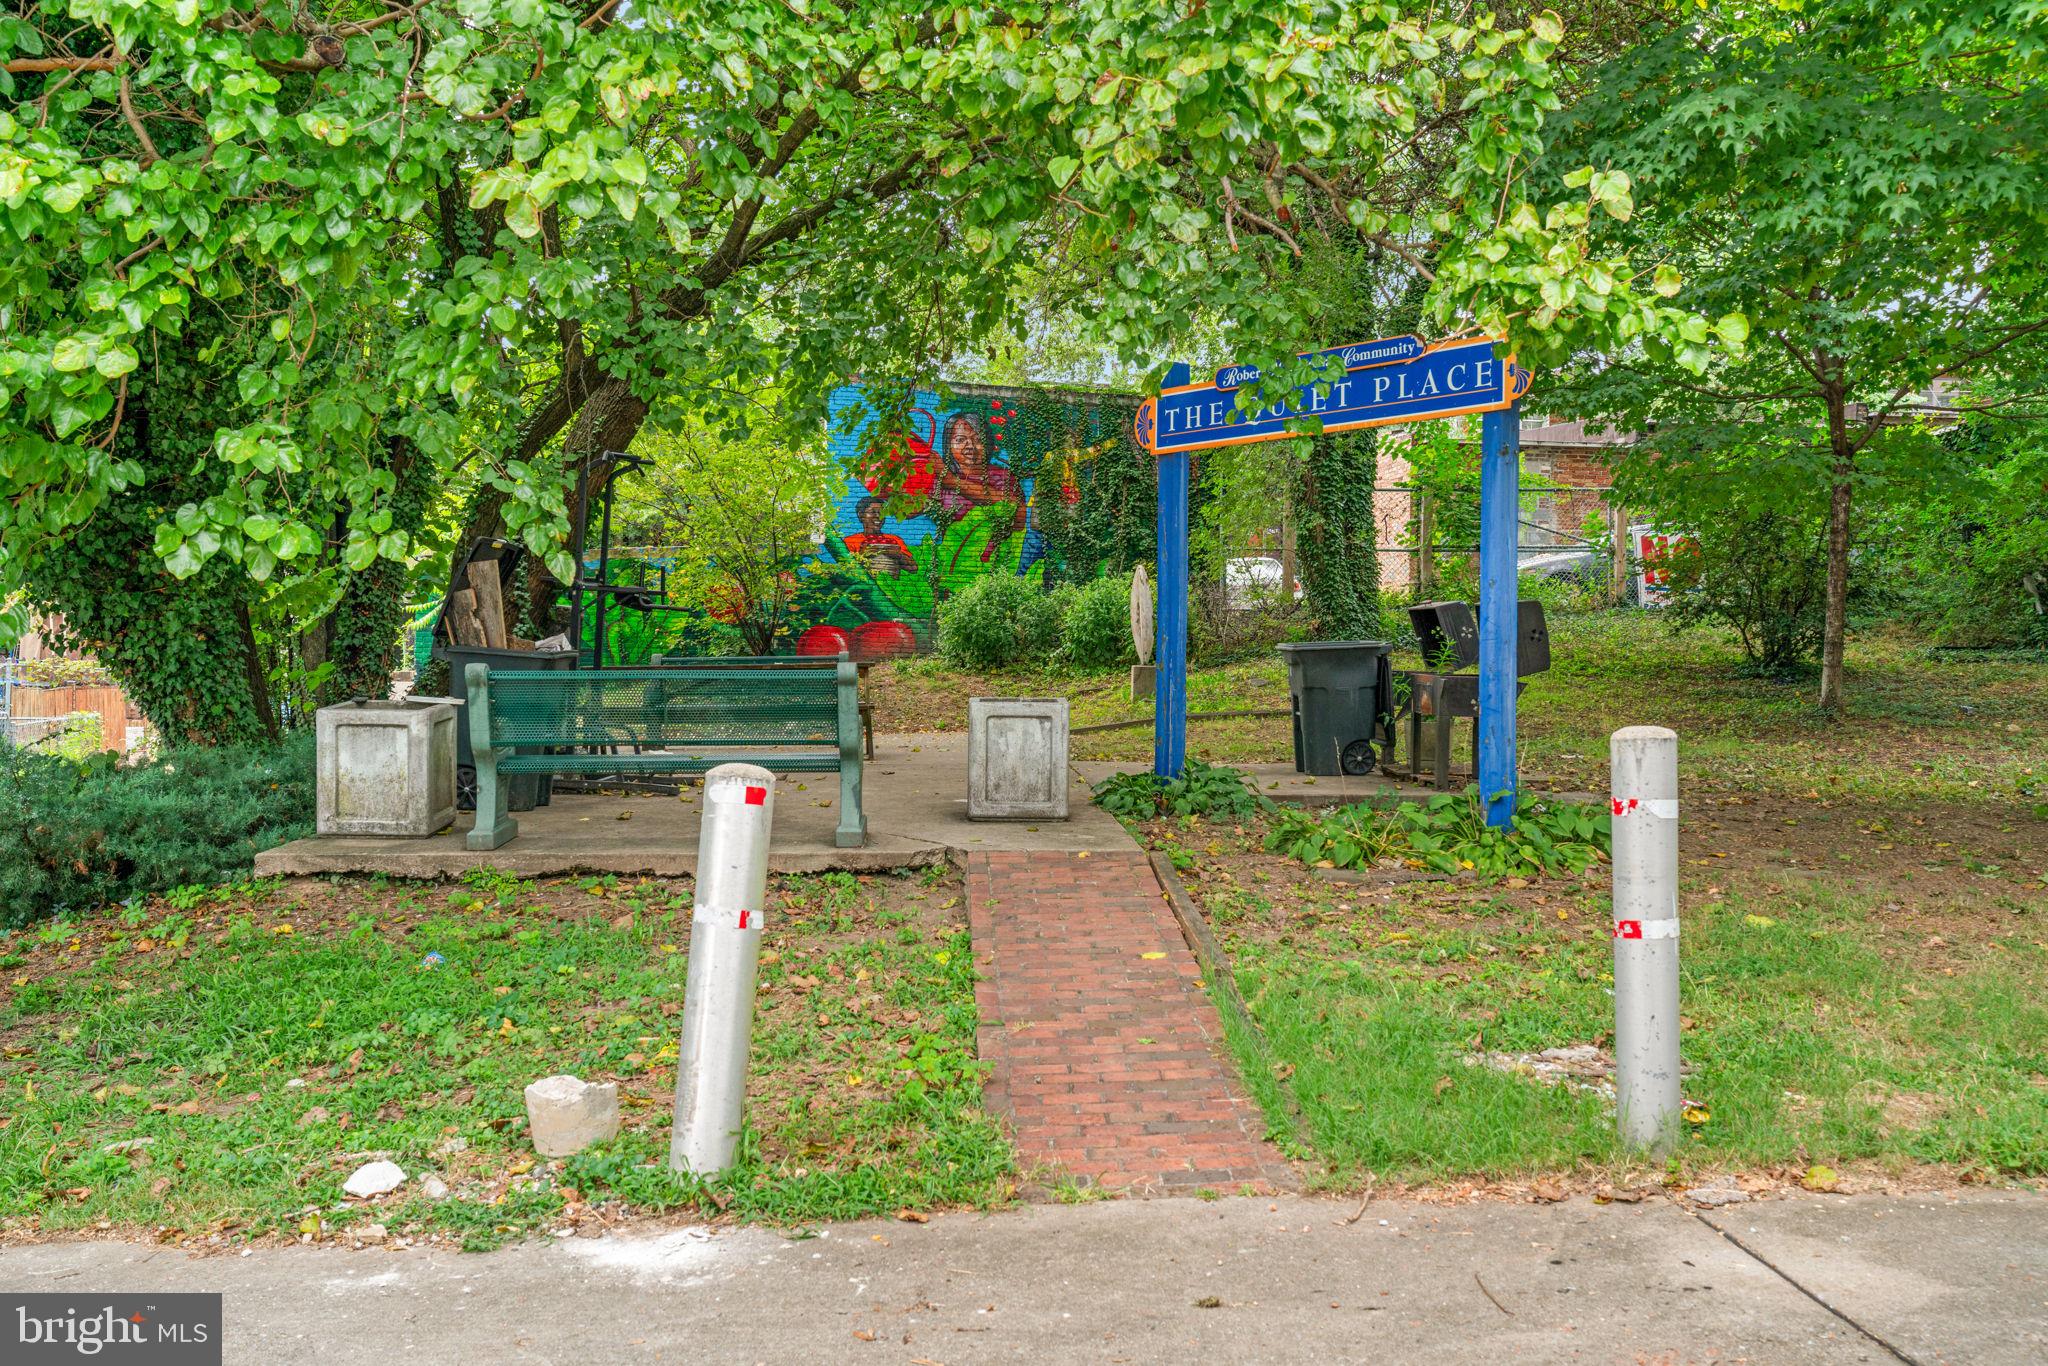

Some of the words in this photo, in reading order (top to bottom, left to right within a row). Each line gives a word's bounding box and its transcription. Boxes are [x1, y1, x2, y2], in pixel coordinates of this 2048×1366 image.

[1222, 367, 1261, 387] Rober
[1341, 342, 1415, 367] Community
[1164, 401, 1223, 432] THE
[1244, 381, 1352, 426] QUET
[1373, 358, 1493, 403] PLACE
